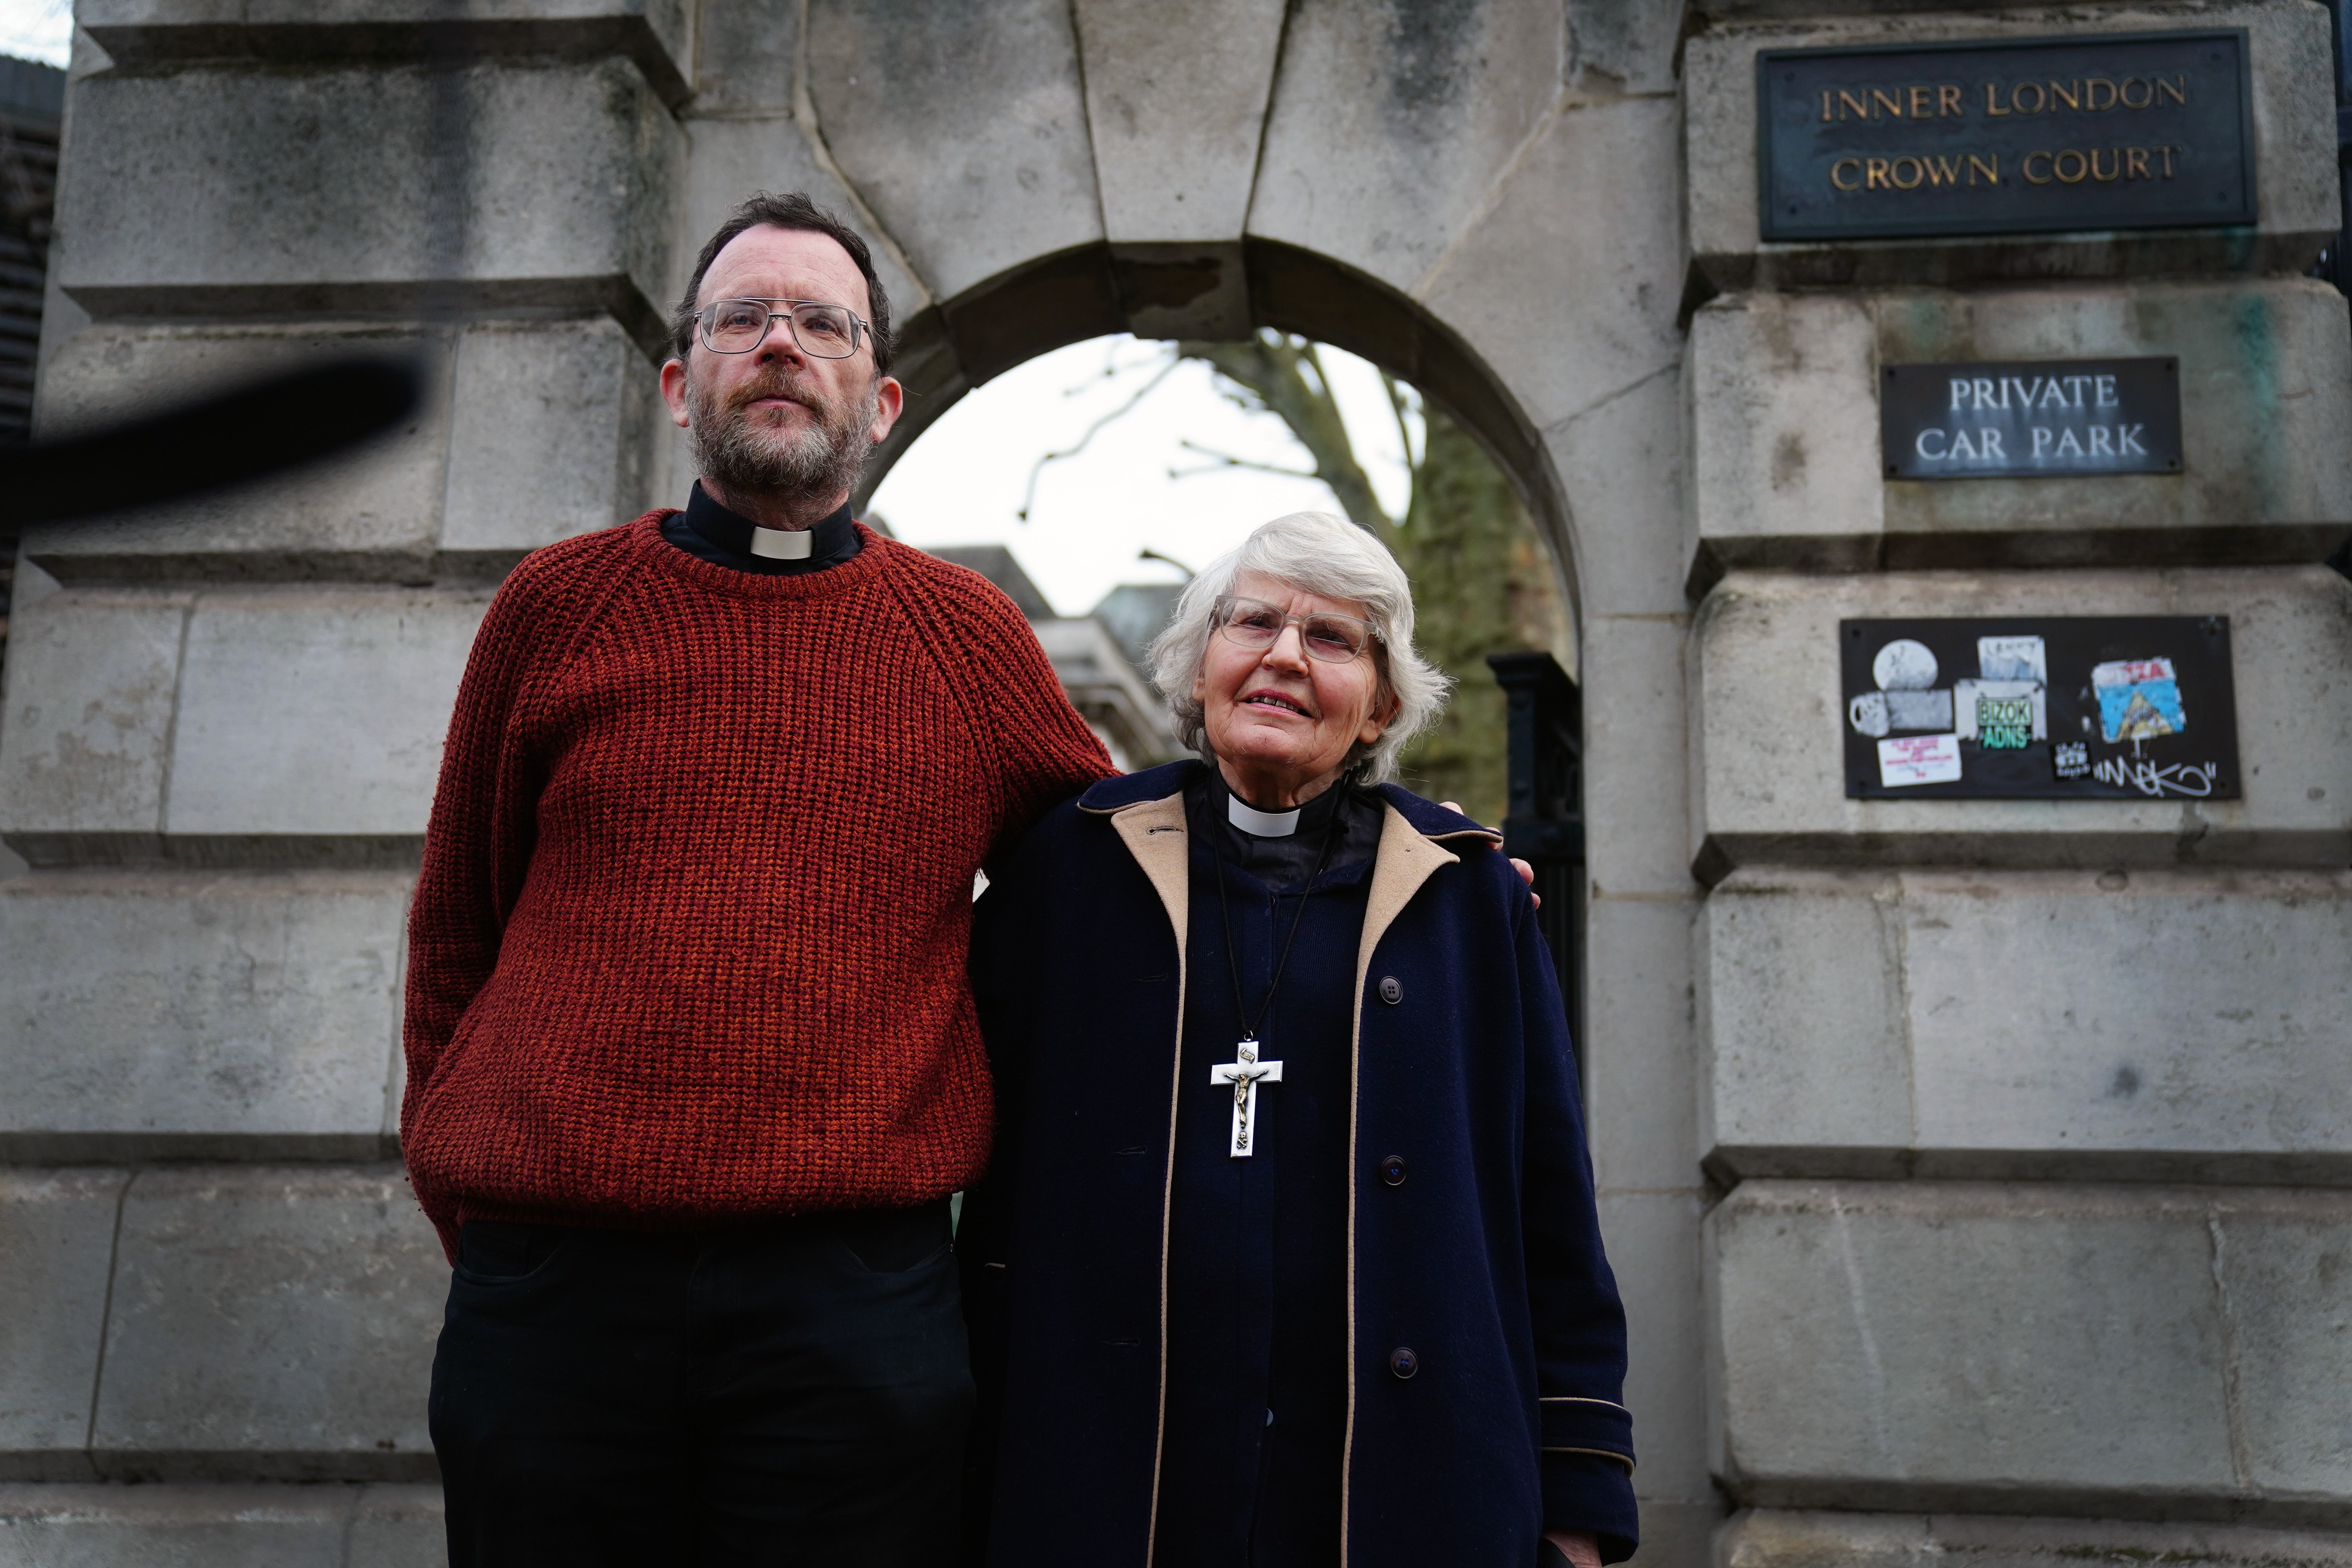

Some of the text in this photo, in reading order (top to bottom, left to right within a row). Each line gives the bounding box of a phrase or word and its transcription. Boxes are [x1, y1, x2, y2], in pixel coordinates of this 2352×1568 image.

[1820, 75, 2187, 122] INNER LONDON
[1831, 146, 2182, 191] CROWN COURT
[1949, 375, 2118, 411] PRIVATE
[1915, 425, 2148, 460] CAR PARK
